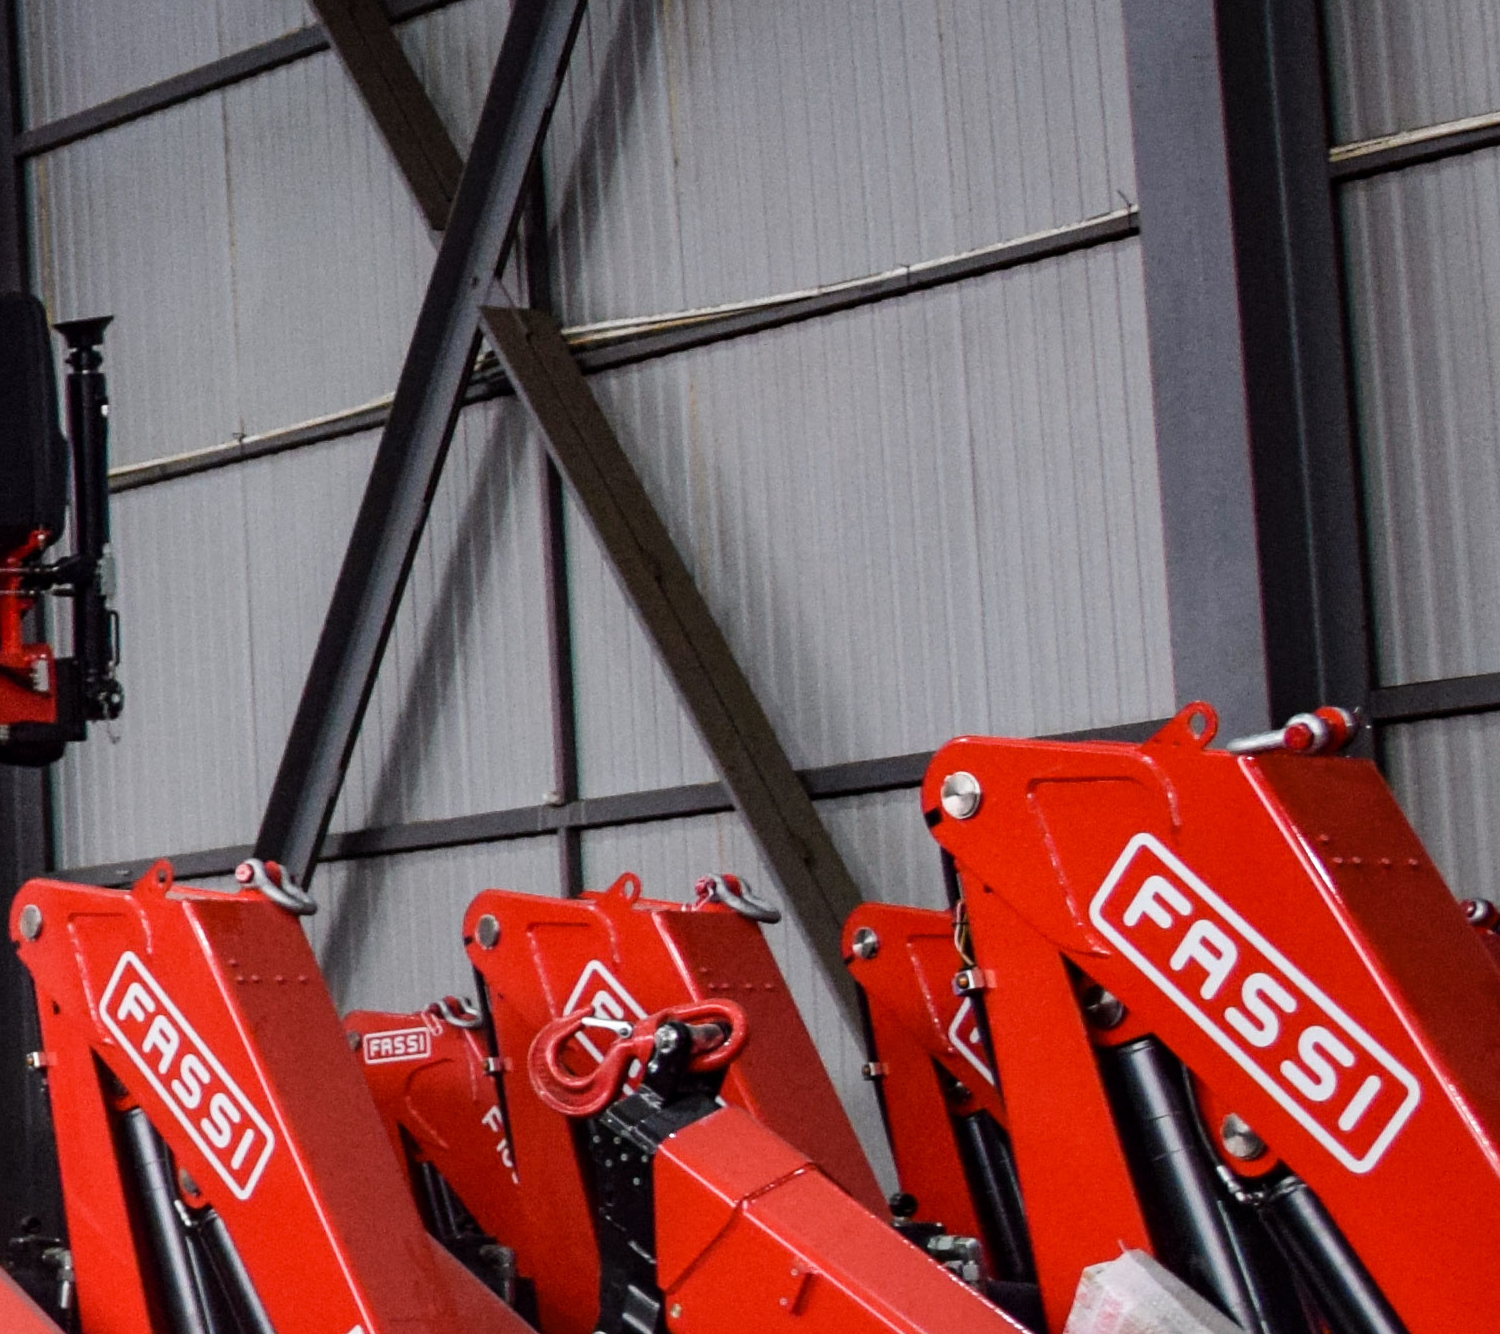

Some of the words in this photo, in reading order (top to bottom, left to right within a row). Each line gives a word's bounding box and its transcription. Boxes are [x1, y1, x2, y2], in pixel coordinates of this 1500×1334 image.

[117, 982, 255, 1170] FASSI
[369, 1034, 425, 1057] FASSI
[1122, 875, 1382, 1132] FASSI
